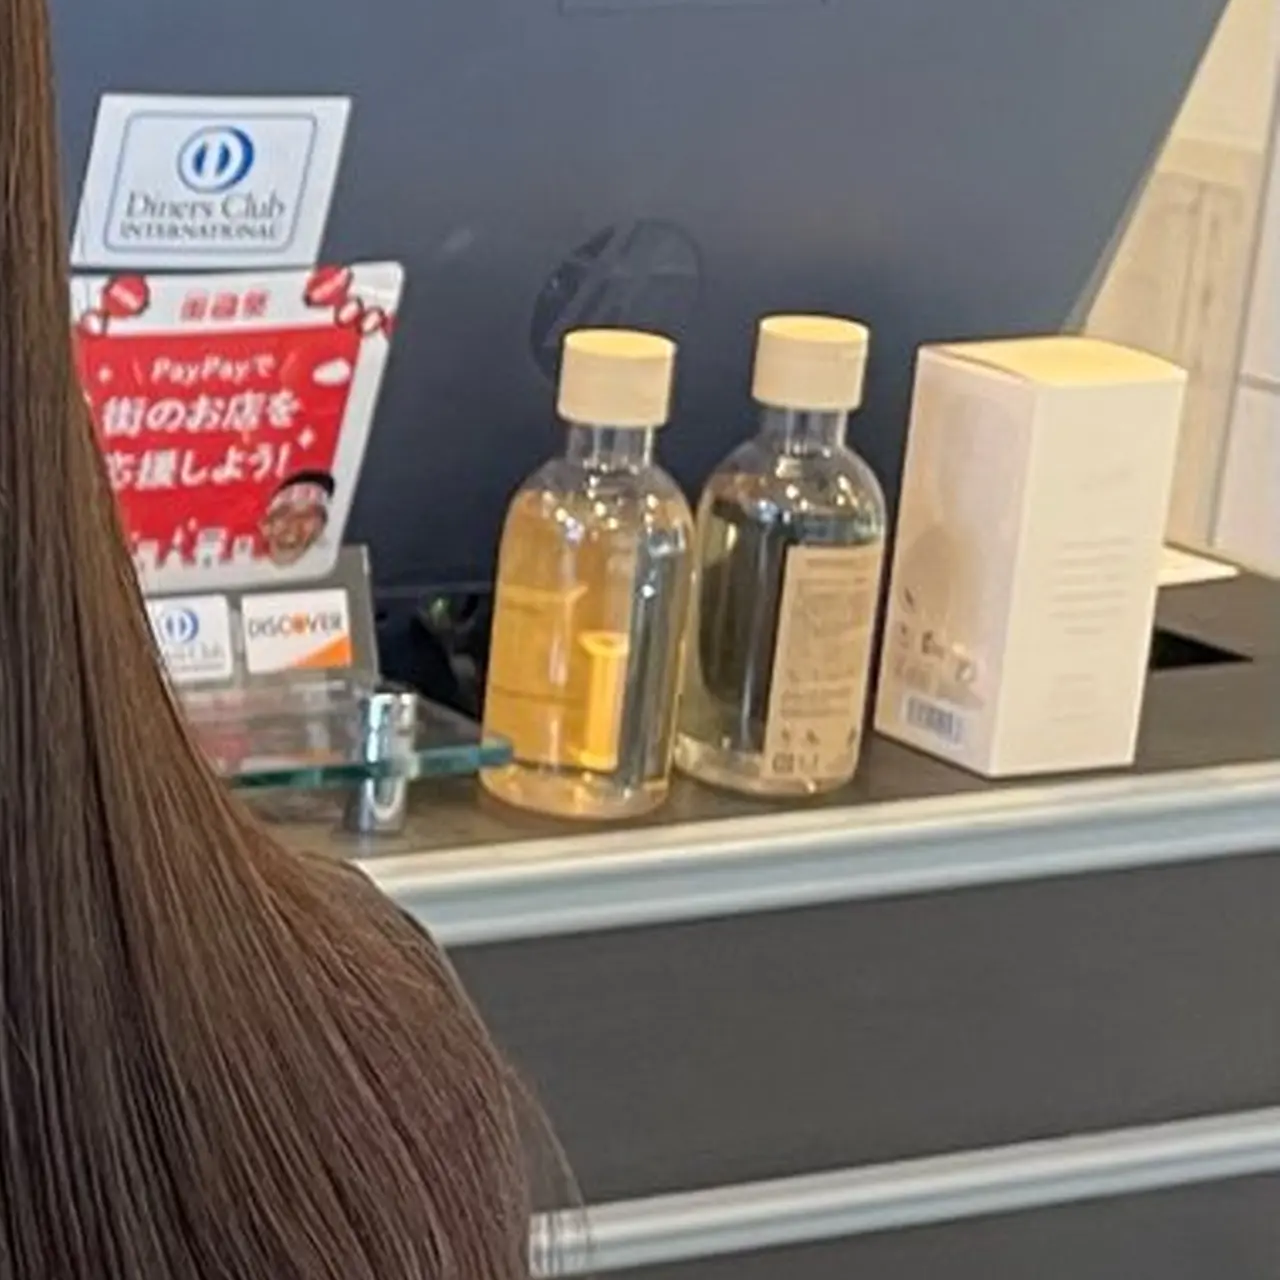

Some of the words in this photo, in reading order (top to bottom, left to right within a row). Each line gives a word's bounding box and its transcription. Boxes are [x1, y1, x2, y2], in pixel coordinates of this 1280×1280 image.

[125, 190, 213, 219] Diners
[220, 190, 286, 219] Club
[120, 221, 278, 240] INTERNATIONAL
[103, 387, 302, 438] 街のお店を
[248, 613, 344, 639] DISCOVER
